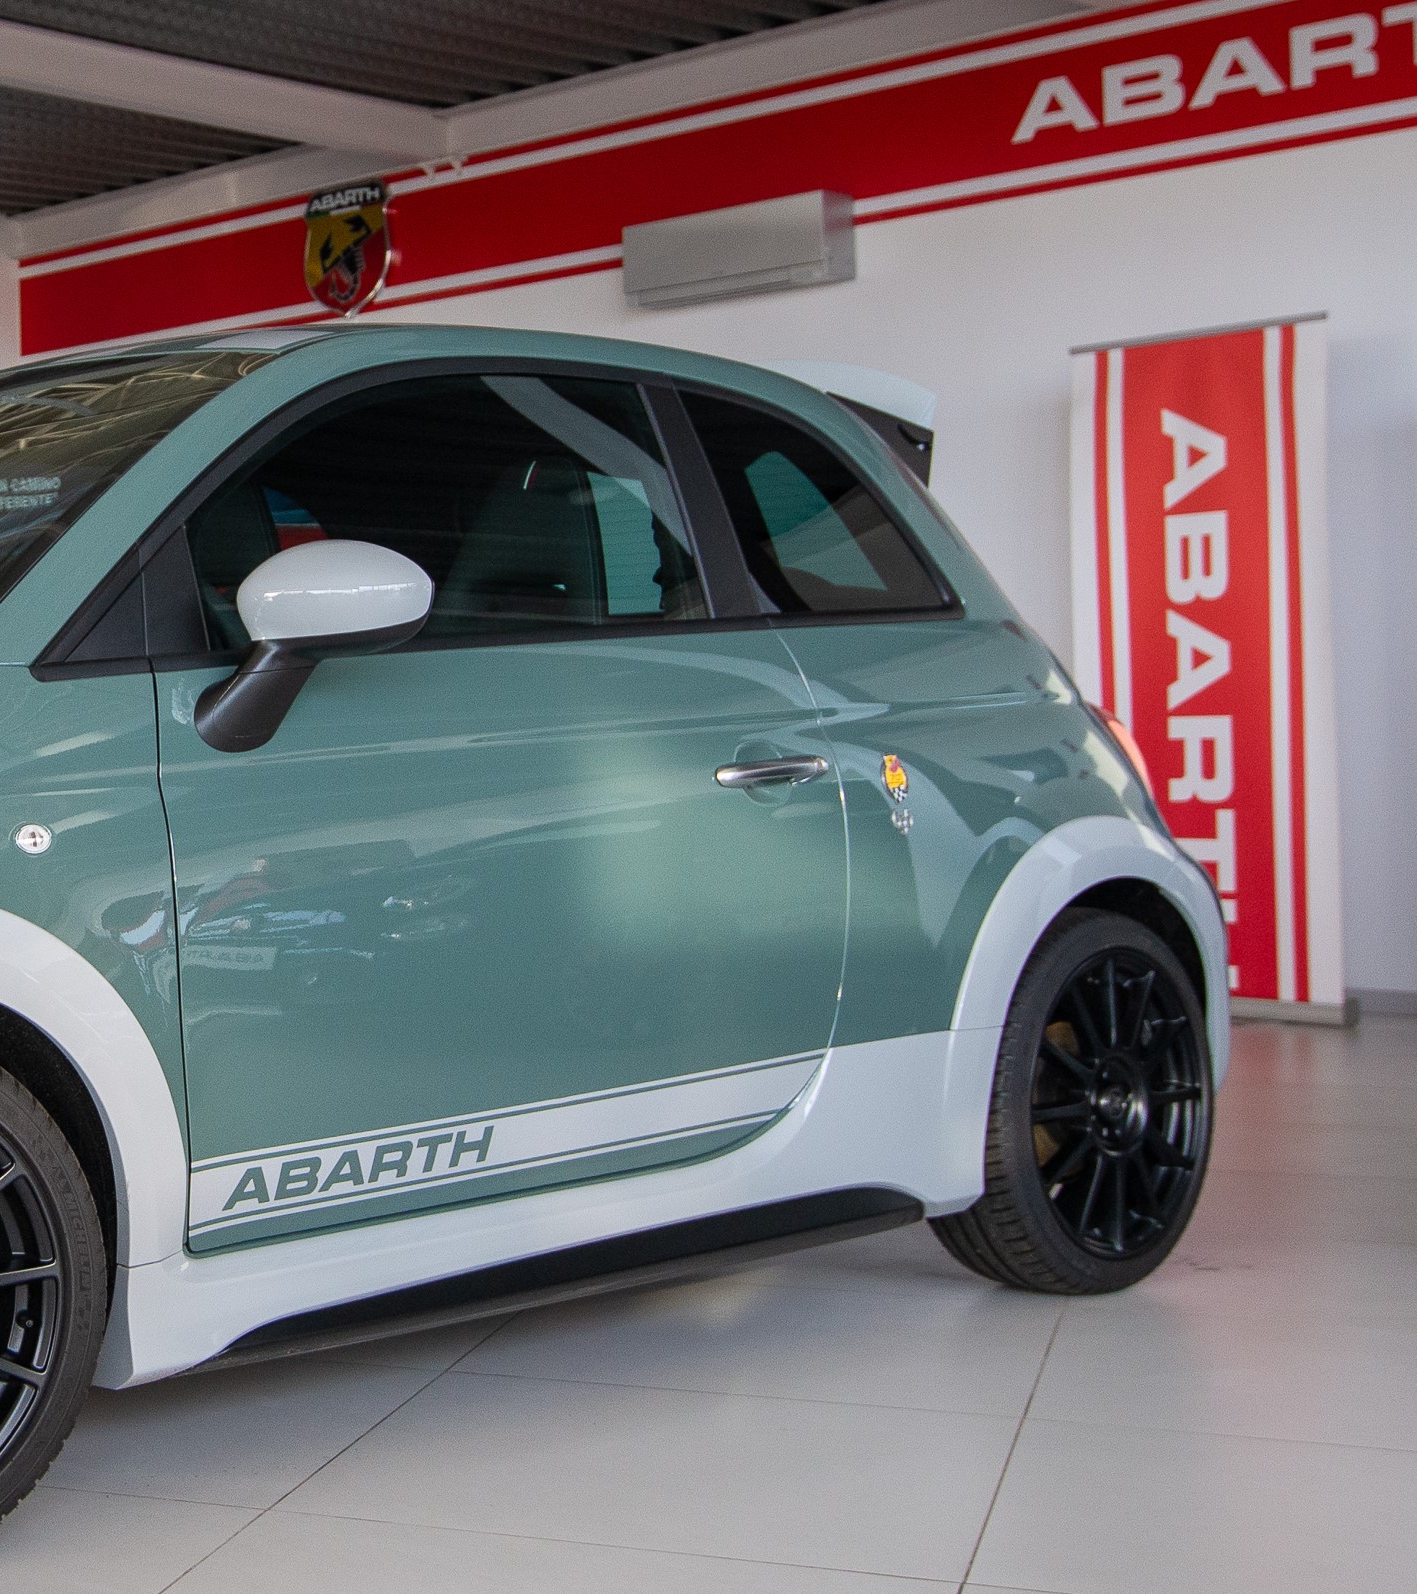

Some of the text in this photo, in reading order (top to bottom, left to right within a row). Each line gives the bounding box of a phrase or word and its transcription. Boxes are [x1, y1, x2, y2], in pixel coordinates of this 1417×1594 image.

[309, 187, 380, 212] ABARTH
[1160, 407, 1239, 991] ABART
[222, 1124, 494, 1212] ABARTH
